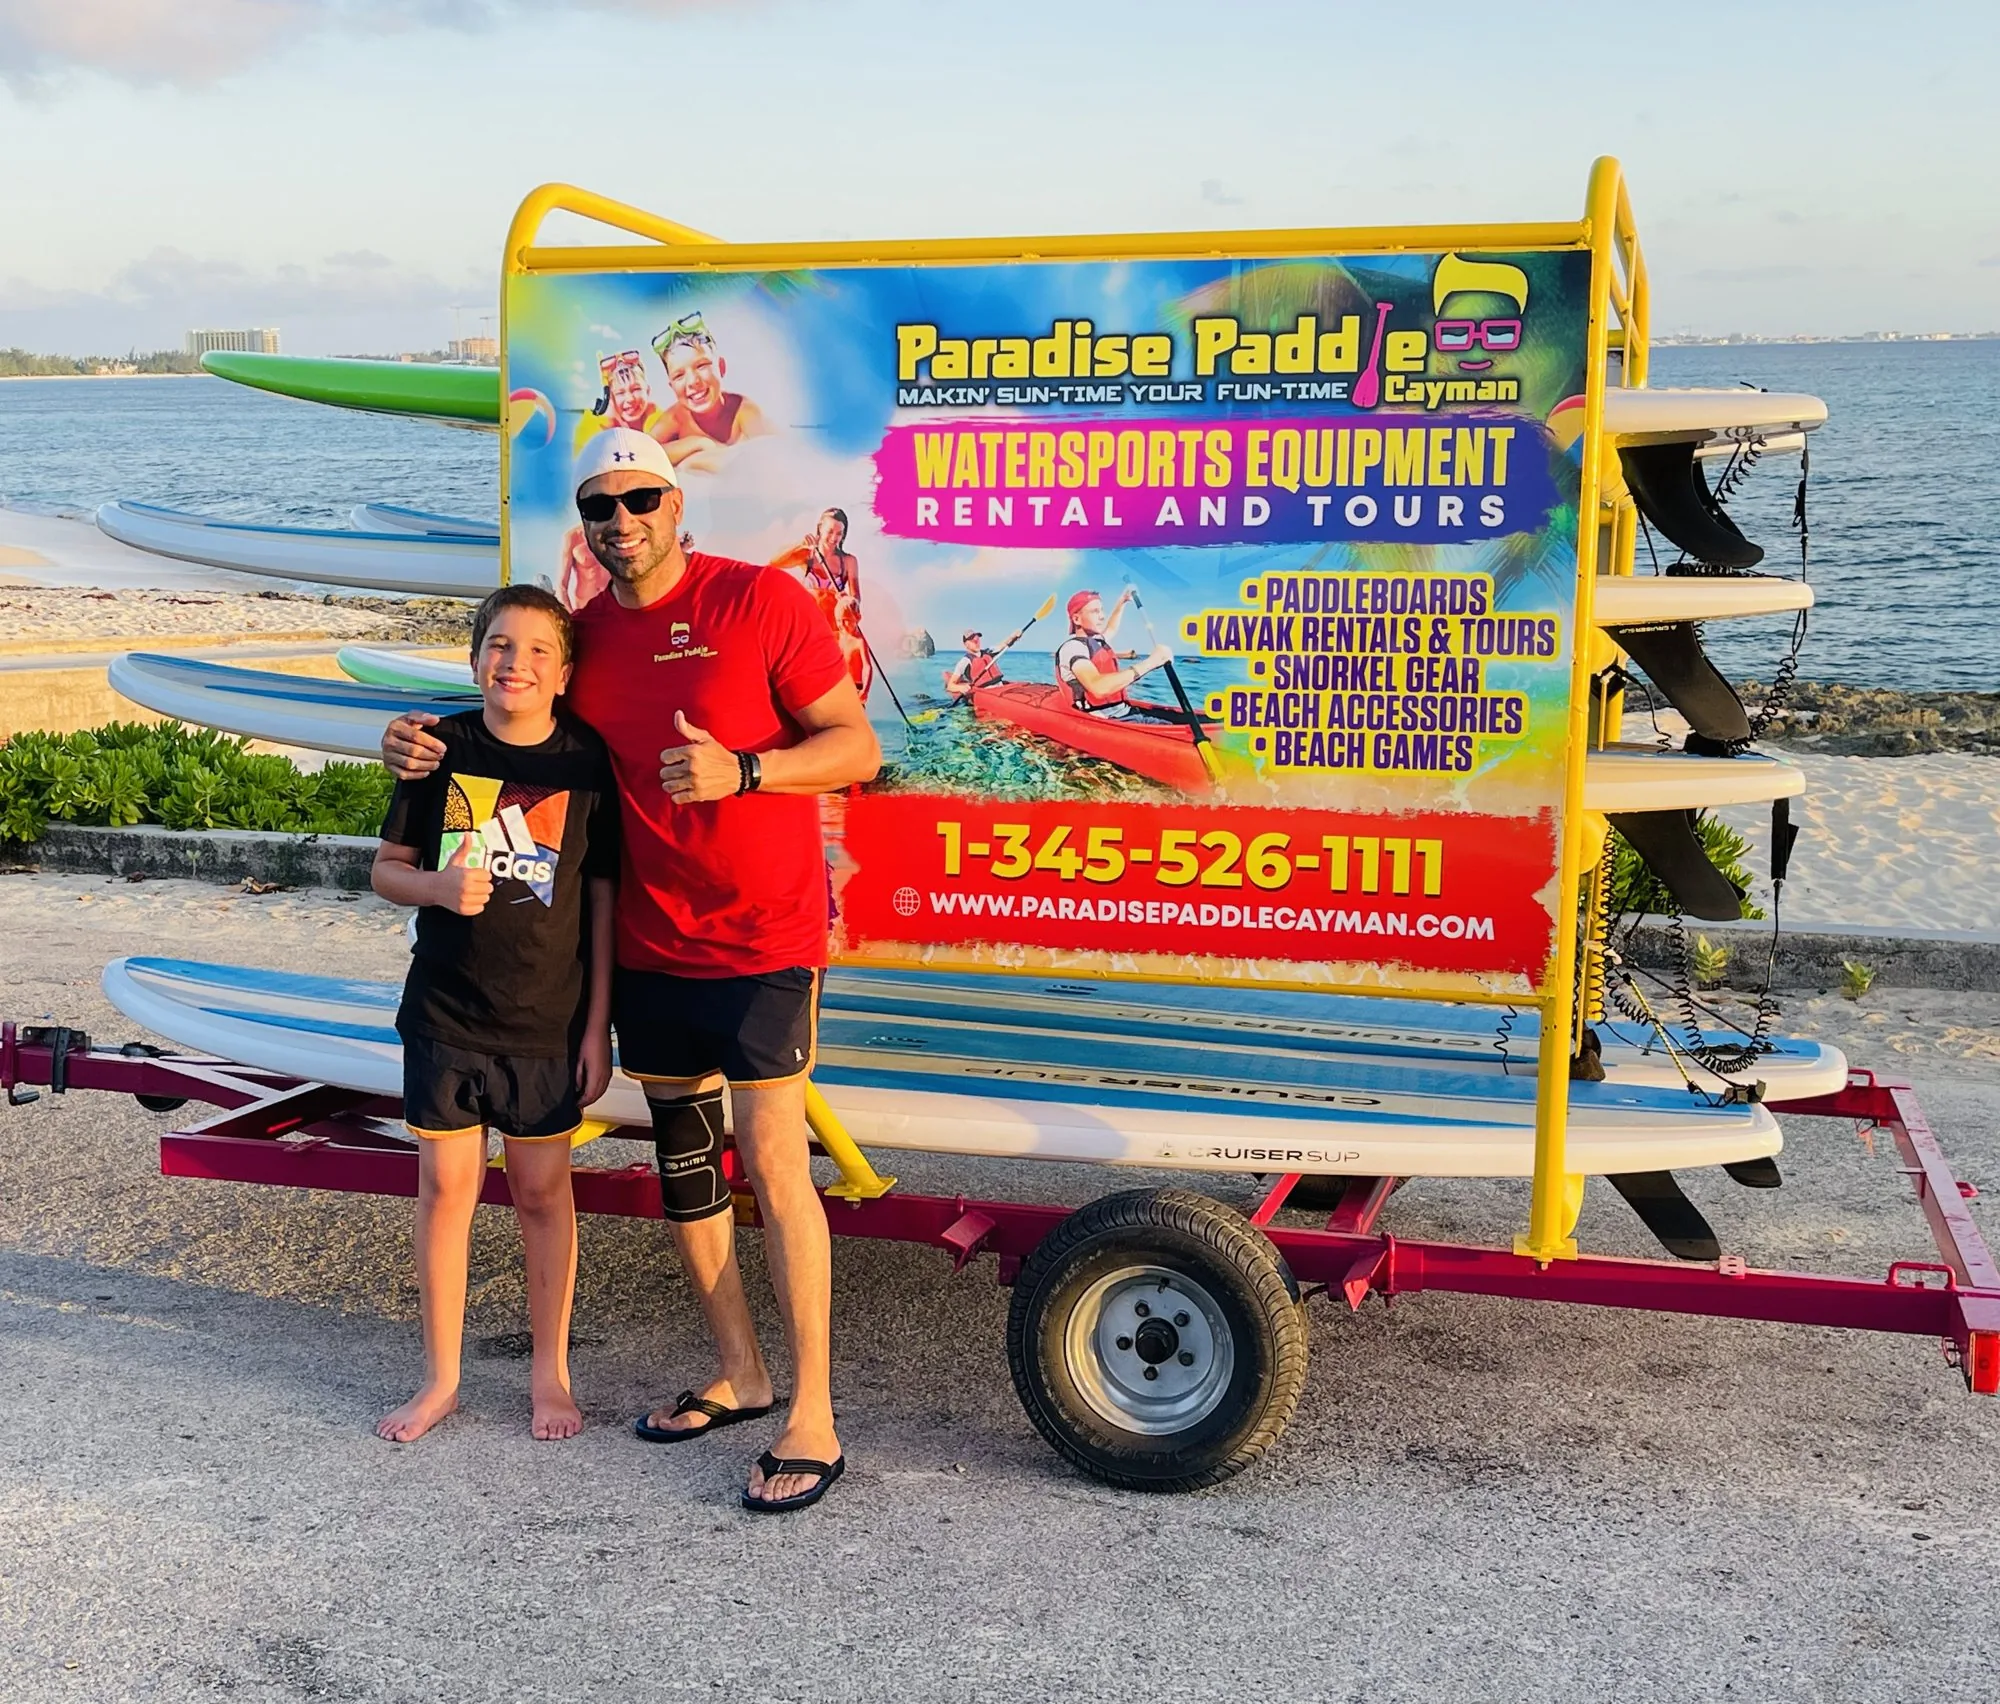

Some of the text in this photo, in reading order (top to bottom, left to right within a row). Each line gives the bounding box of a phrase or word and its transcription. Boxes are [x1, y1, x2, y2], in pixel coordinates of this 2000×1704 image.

[896, 305, 1428, 397] Paradise Paddle
[898, 381, 1349, 406] MAKIN' SUN-TIME YOUR FUN-TIME
[1384, 375, 1519, 410] Cayman
[914, 427, 1516, 493] WATERSPORTS EQUIPMENT
[916, 495, 1507, 527] RENTAL AND TOURS
[1265, 577, 1488, 616] PADDLEBOARDS
[1205, 615, 1556, 657] KAYAK RENTALS & TOURS
[1273, 656, 1480, 694] SNORKEL GEAR
[1230, 694, 1523, 735] BEACH ACCESSORIES
[1274, 733, 1473, 772] BEACH GAMES
[445, 845, 552, 883] didas
[936, 820, 1444, 897] 1-345-526-1111
[929, 892, 1496, 941] WWW.PARADISEPADDLECAYMAN.COM
